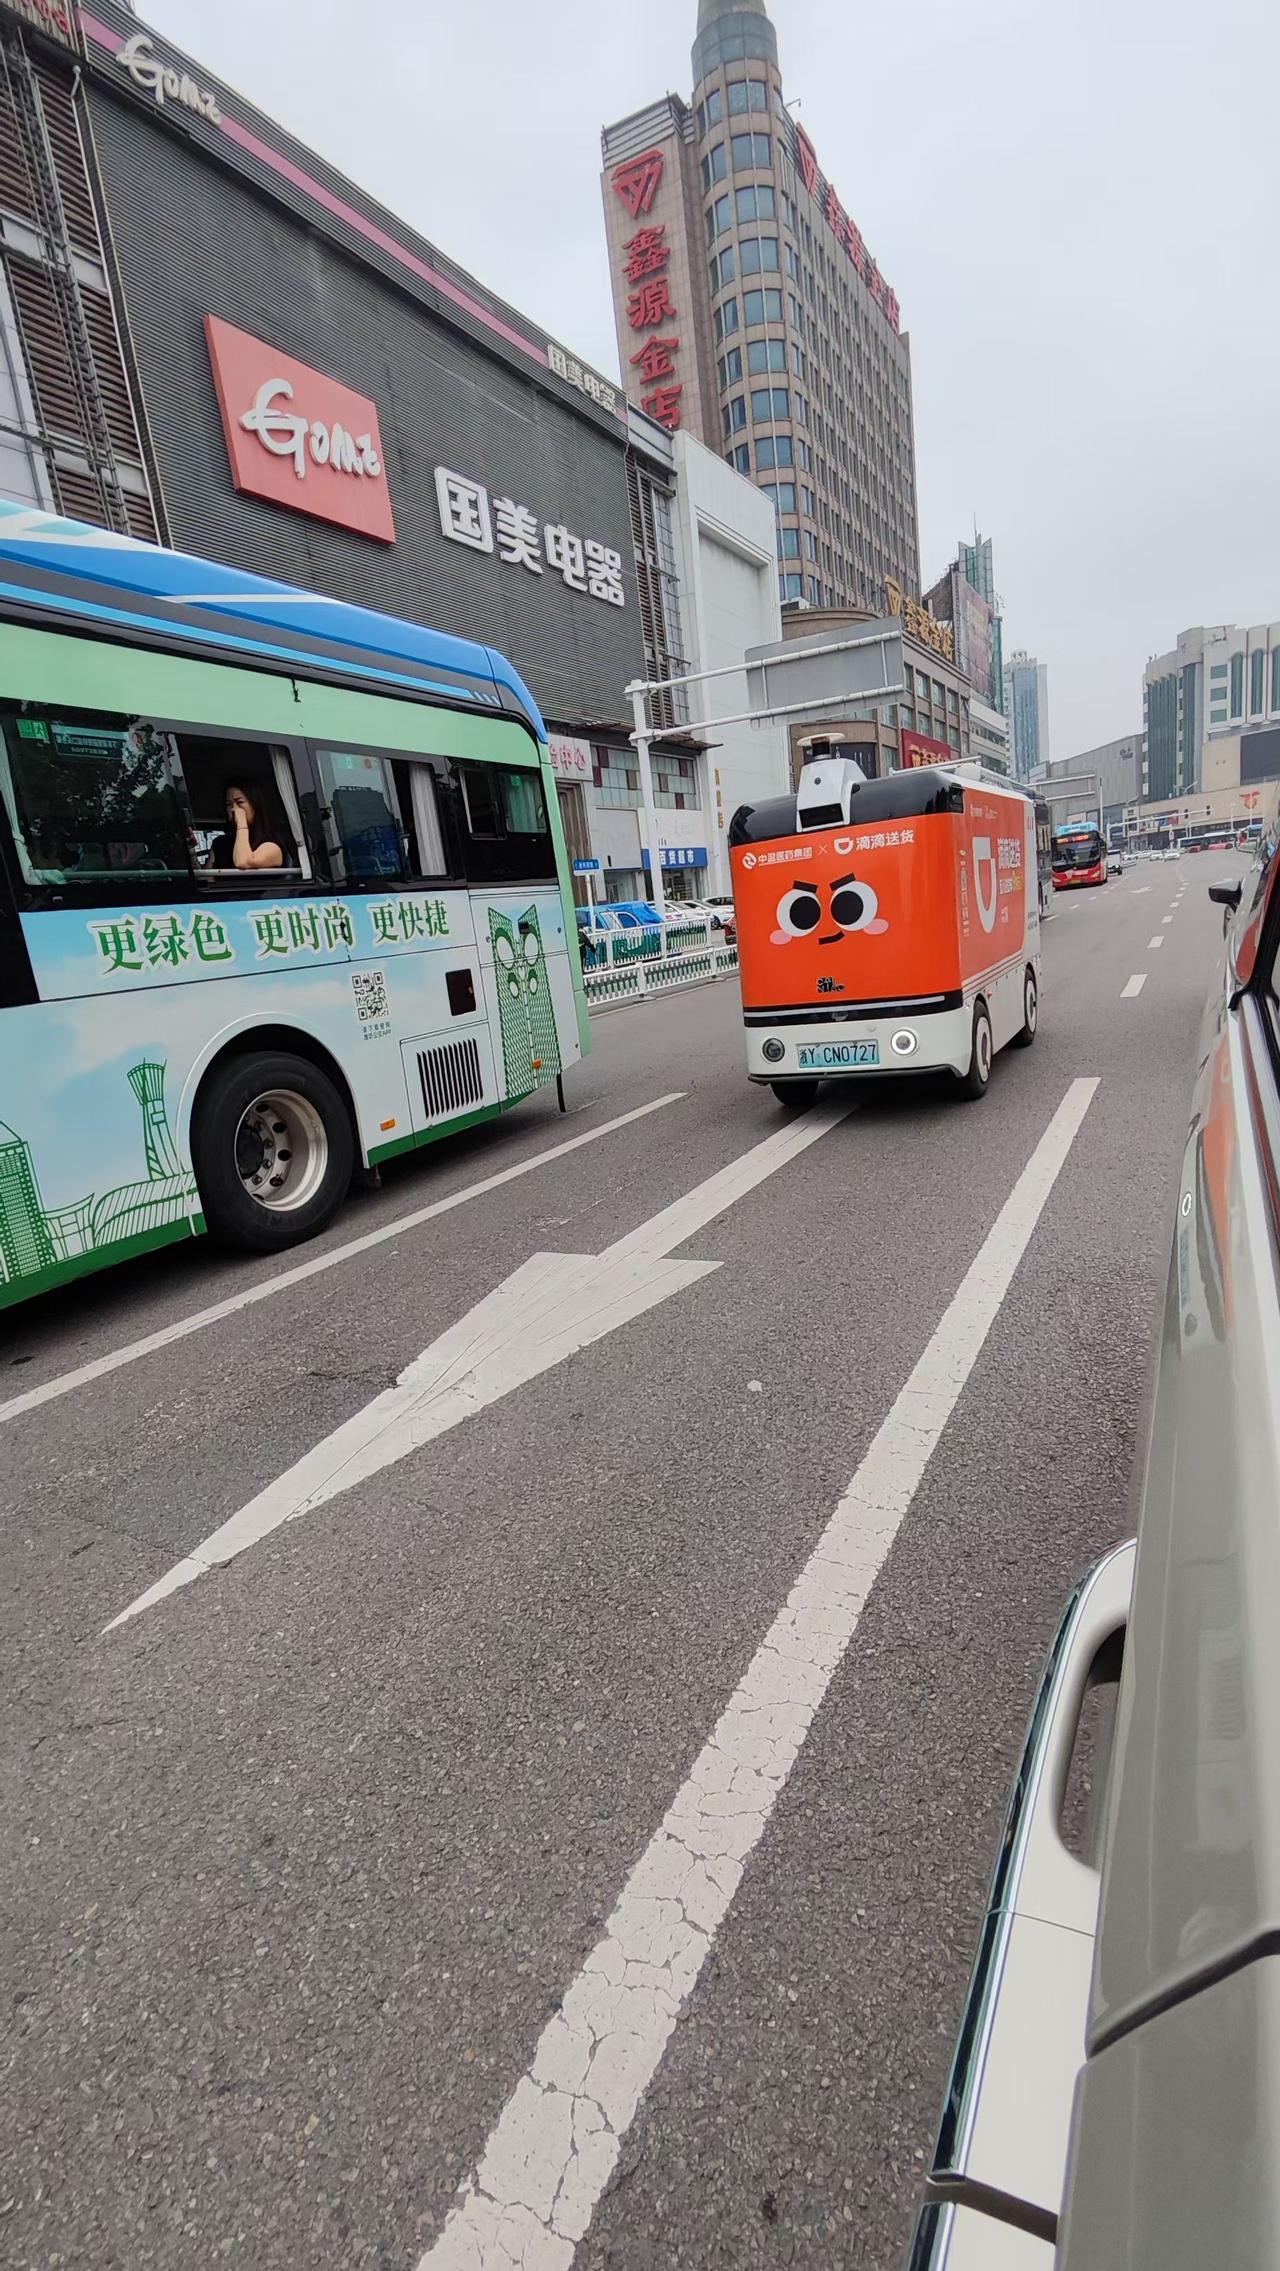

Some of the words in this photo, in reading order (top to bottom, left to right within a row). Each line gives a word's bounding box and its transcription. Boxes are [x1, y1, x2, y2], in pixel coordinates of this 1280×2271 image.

[622, 224, 682, 430] 鑫源金店
[548, 344, 616, 416] 国美电器
[434, 466, 625, 607] 国美电器
[855, 830, 915, 851] 滴滴送货
[92, 913, 232, 975] 更绿色
[251, 904, 352, 957] 更时尚
[370, 900, 450, 944] 更快捷
